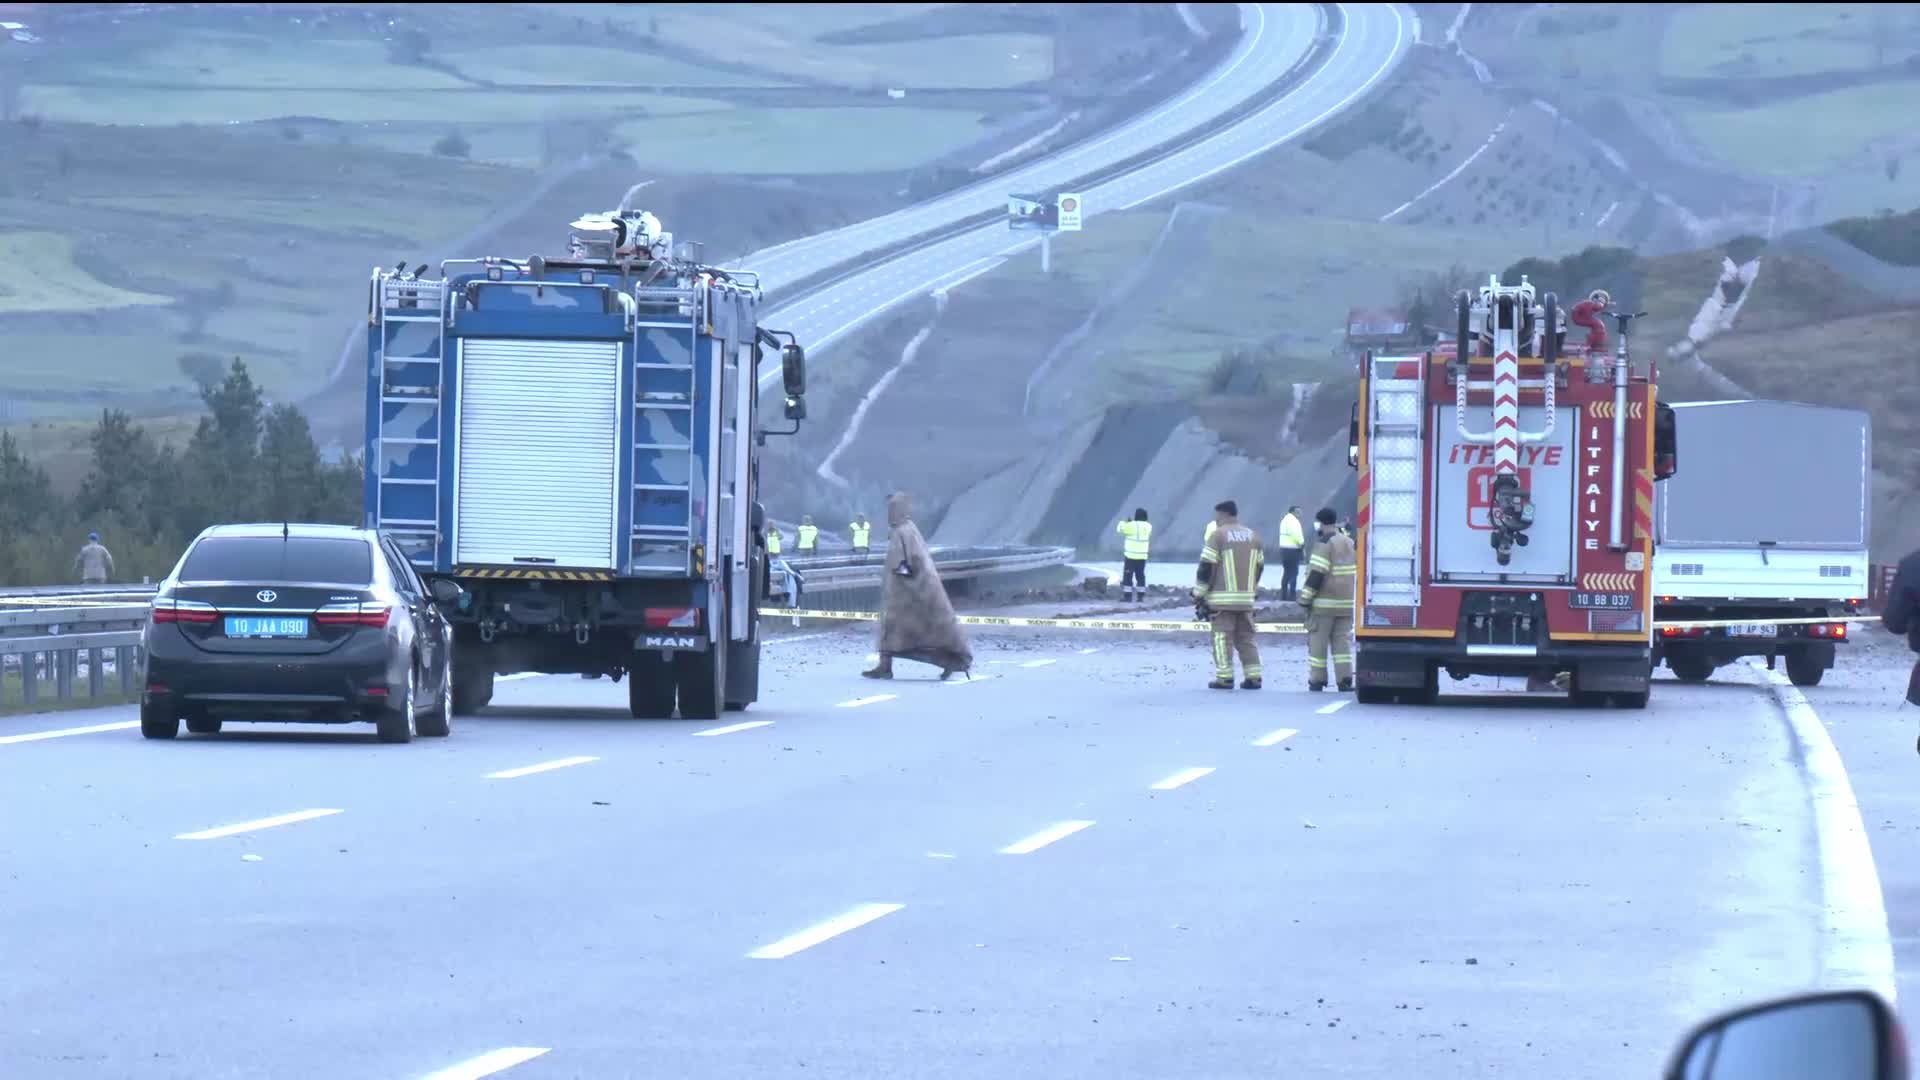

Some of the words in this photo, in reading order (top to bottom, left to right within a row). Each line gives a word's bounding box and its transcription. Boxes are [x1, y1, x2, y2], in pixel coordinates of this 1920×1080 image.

[1577, 594, 1588, 605] 10
[1612, 595, 1630, 606] 037
[234, 619, 248, 633] 10
[255, 620, 276, 633] JAA
[280, 620, 303, 633] 090
[646, 637, 695, 647] MAN
